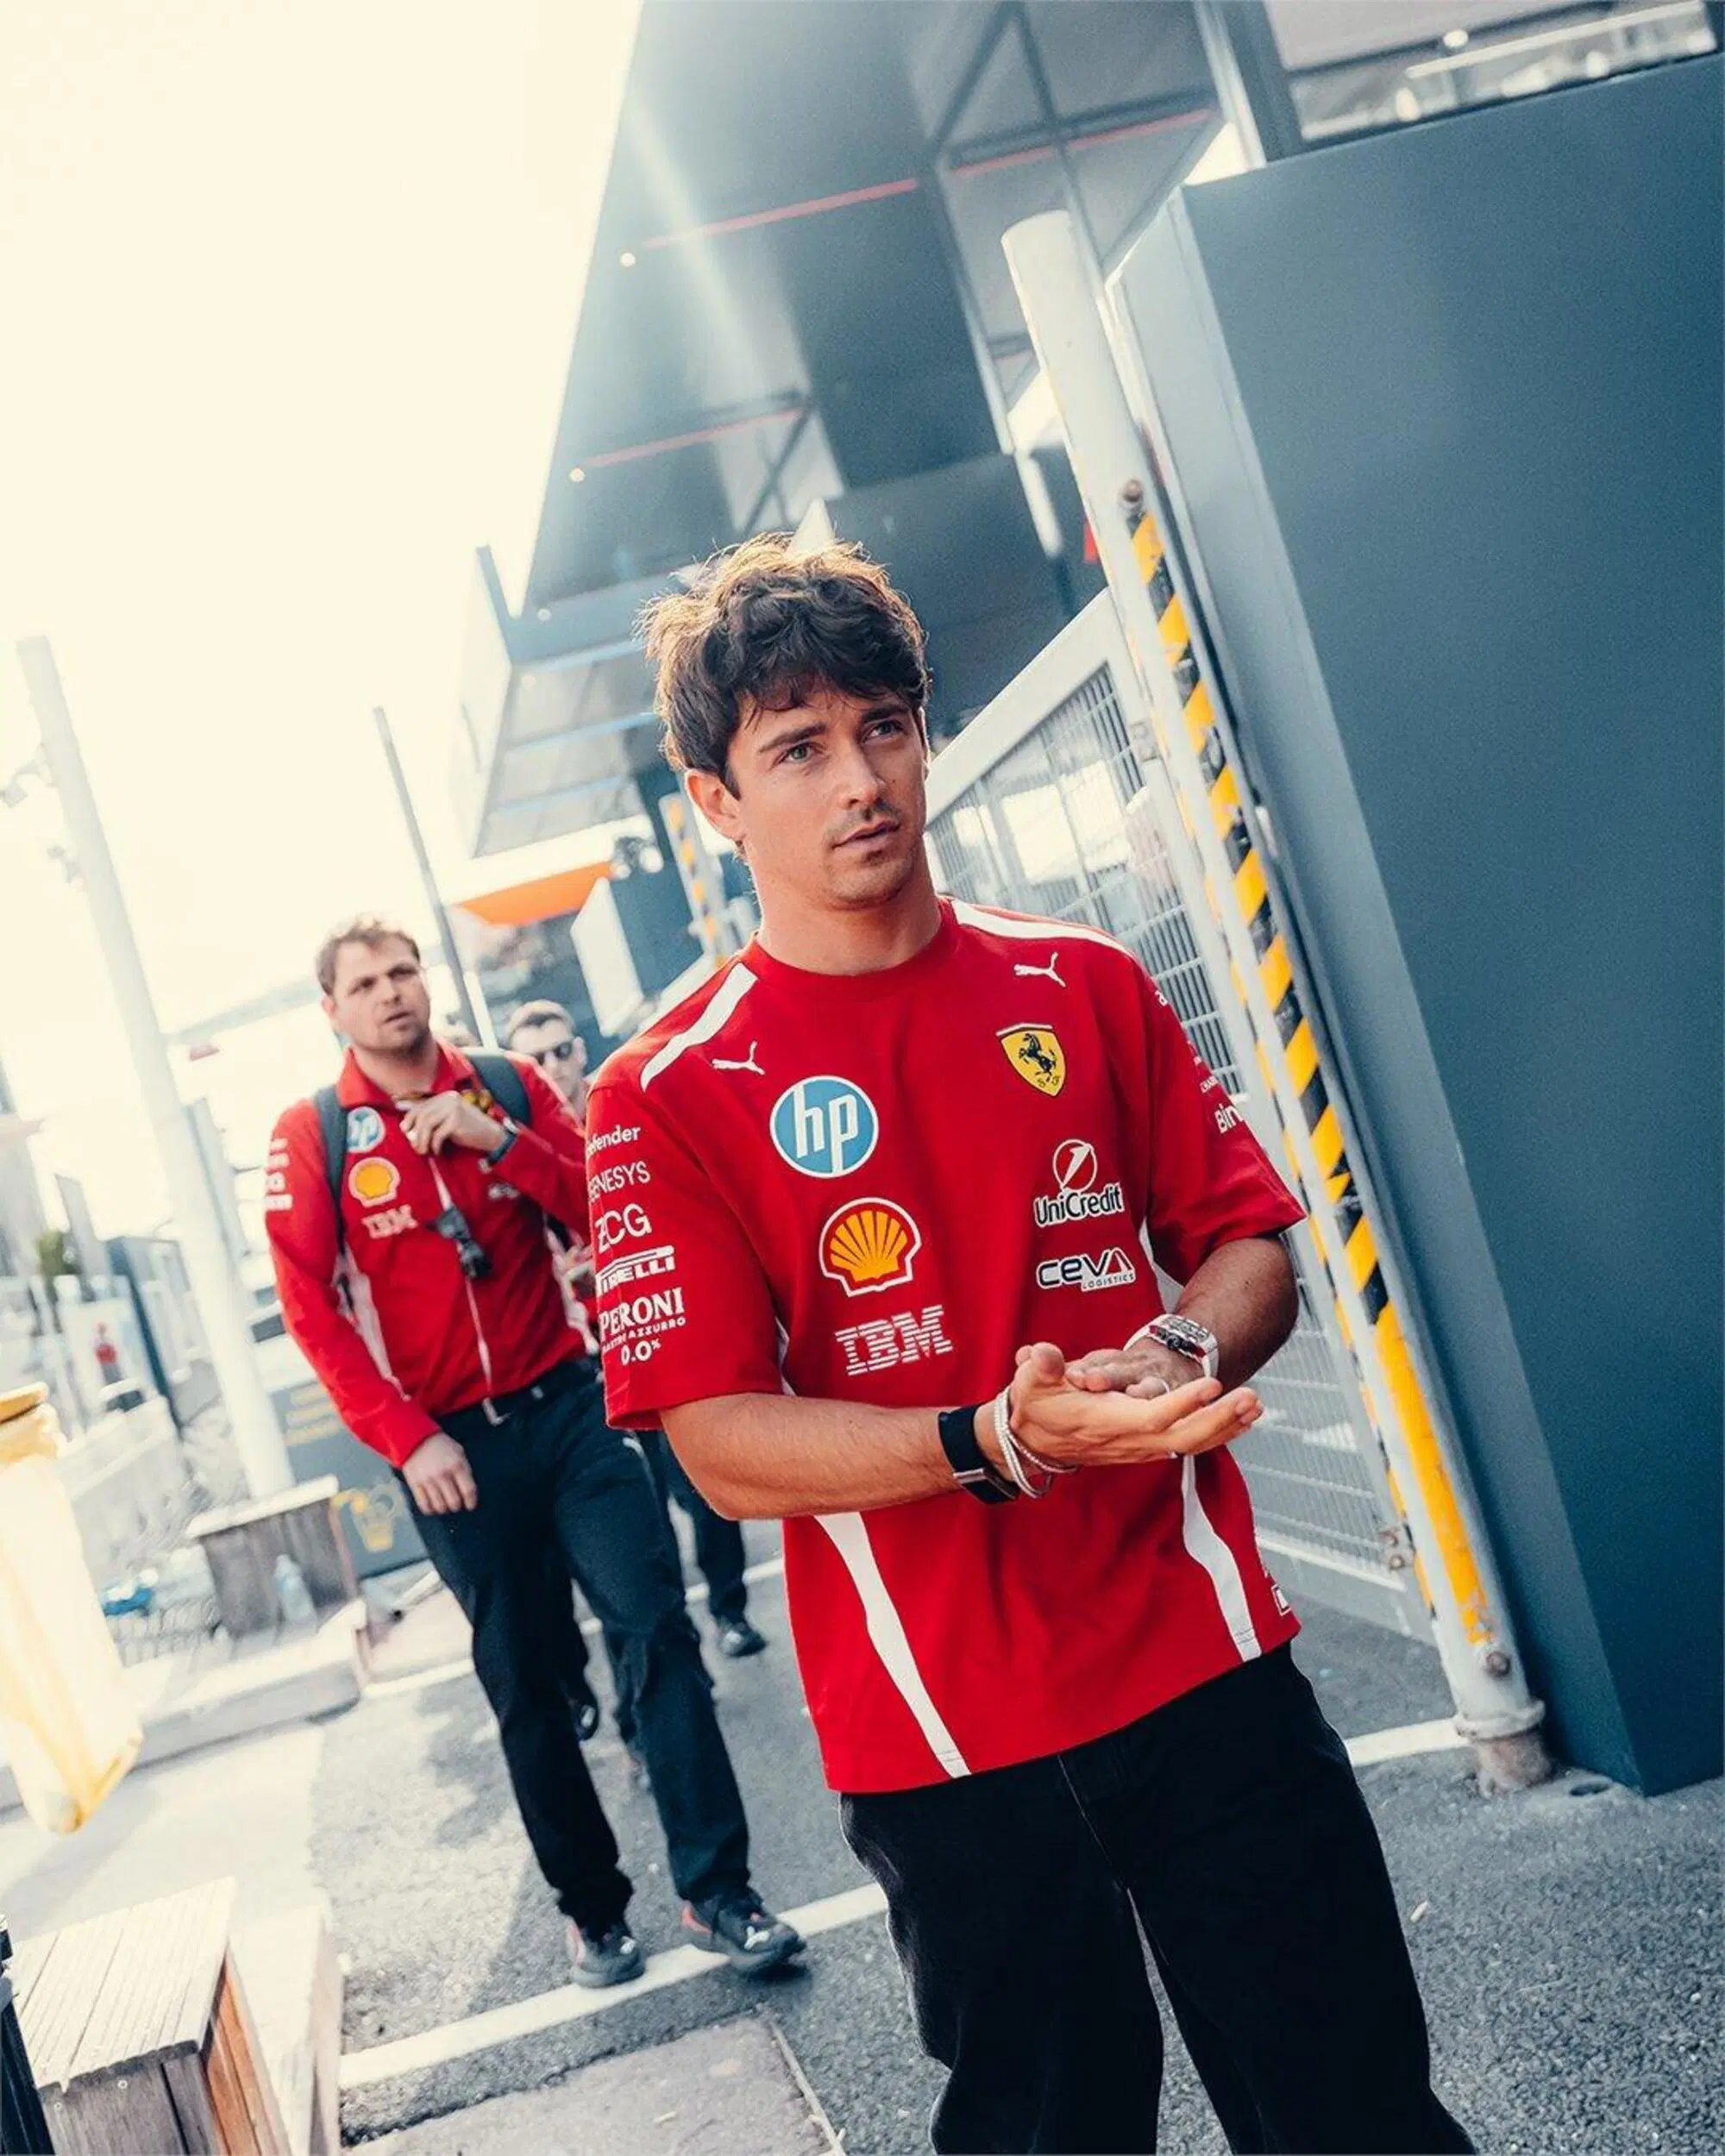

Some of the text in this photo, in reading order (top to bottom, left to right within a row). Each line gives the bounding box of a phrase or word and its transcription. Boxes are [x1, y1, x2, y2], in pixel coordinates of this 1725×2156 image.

[794, 1084, 859, 1175] hp
[1036, 1185, 1123, 1225] UniCredit
[595, 1245, 675, 1298] PIRELLI
[598, 1287, 685, 1338] PERONI
[834, 1304, 953, 1376] IBM
